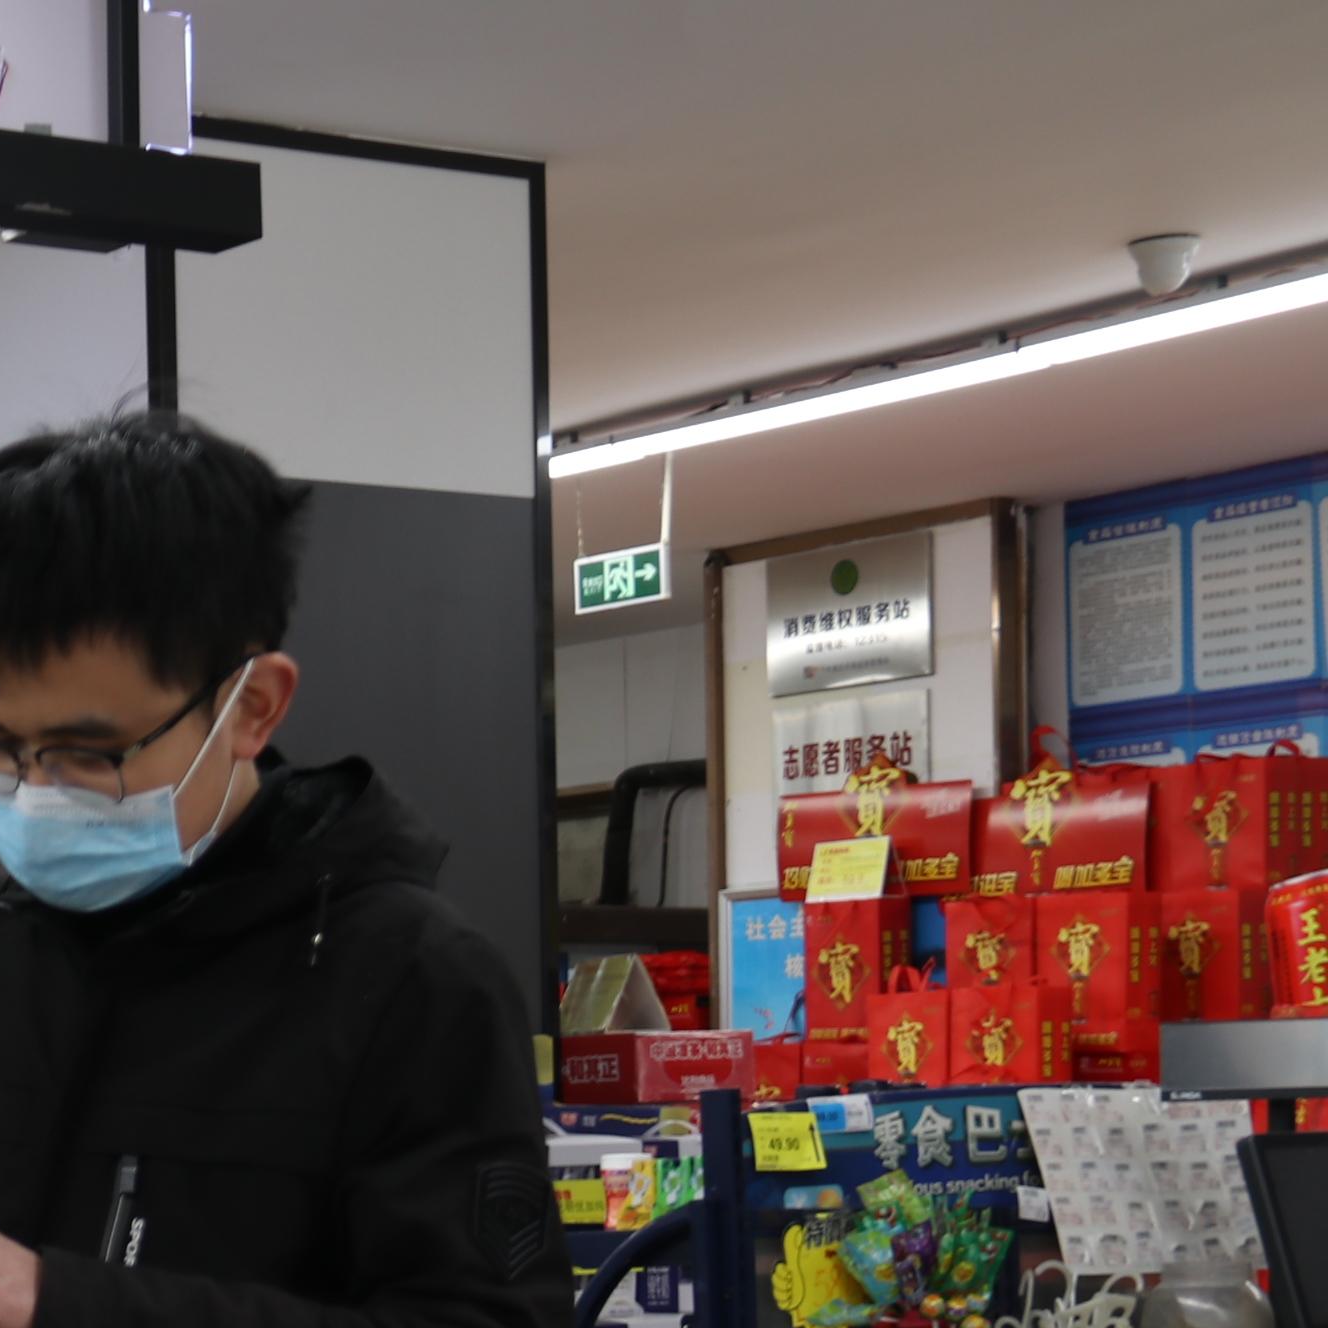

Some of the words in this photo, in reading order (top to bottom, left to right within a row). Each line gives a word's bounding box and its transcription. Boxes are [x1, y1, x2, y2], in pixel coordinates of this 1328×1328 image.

[784, 598, 911, 639] 消费维权服务站
[782, 731, 913, 780] 志愿者服务站
[903, 853, 961, 881] 加多宝
[873, 1105, 1036, 1170] 零食巴
[945, 1172, 1021, 1194] snacking
